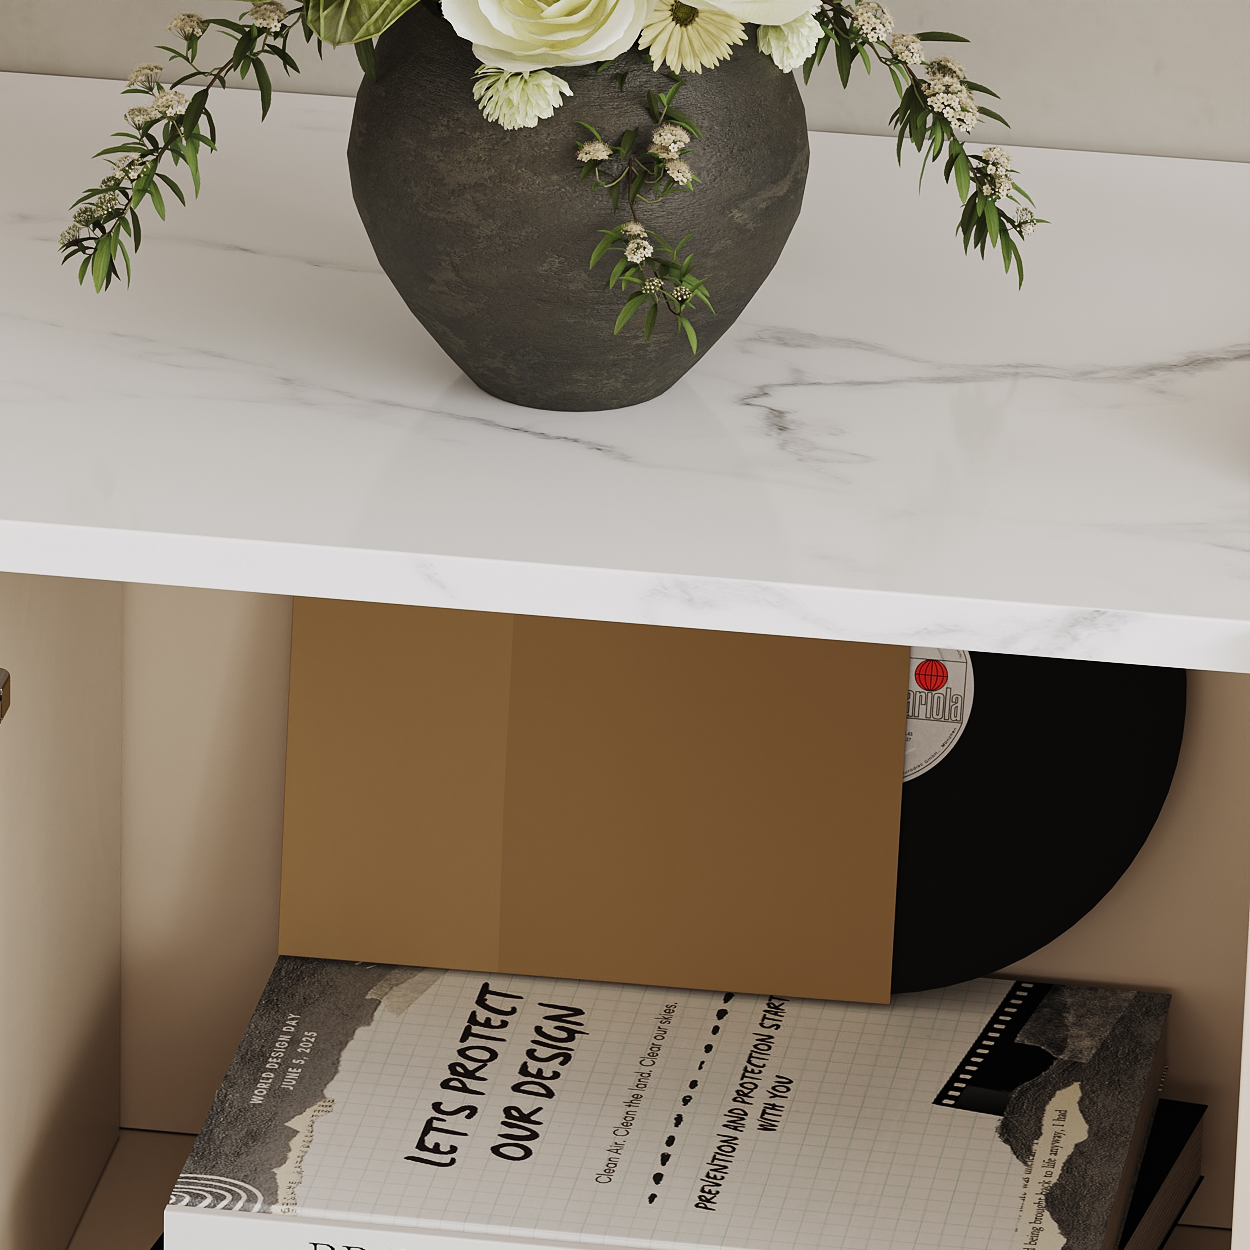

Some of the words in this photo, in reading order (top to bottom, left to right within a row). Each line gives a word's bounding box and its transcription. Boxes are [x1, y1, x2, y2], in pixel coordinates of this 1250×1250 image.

[654, 1002, 678, 1025] skies.
[297, 1031, 317, 1053] 2025
[439, 982, 524, 1096] PROTECT
[653, 1026, 669, 1041] our
[250, 1072, 275, 1104] WORLD
[265, 1034, 292, 1069] DESIGN
[282, 1013, 301, 1032] DAY
[291, 1056, 309, 1065] 5,
[511, 1002, 590, 1099] DESIGN
[639, 1043, 662, 1067] Clear
[280, 1067, 302, 1090] JUNE
[628, 1070, 652, 1091] land.
[732, 1033, 775, 1106] PROTECTION
[767, 1075, 794, 1100] YOU
[623, 1093, 643, 1107] the
[613, 1111, 638, 1137] Clean
[722, 1106, 748, 1132] AND
[757, 1102, 785, 1132] WITH
[1052, 1109, 1068, 1122] had
[490, 1105, 544, 1161] OUR
[1049, 1129, 1067, 1156] anyway,
[606, 1140, 626, 1155] Air.
[595, 1157, 621, 1184] Clean
[694, 1133, 739, 1211] PREVENTION
[1041, 1158, 1057, 1169] life
[1043, 1170, 1054, 1178] to
[1029, 1197, 1046, 1225] brought
[1023, 1226, 1045, 1246] being
